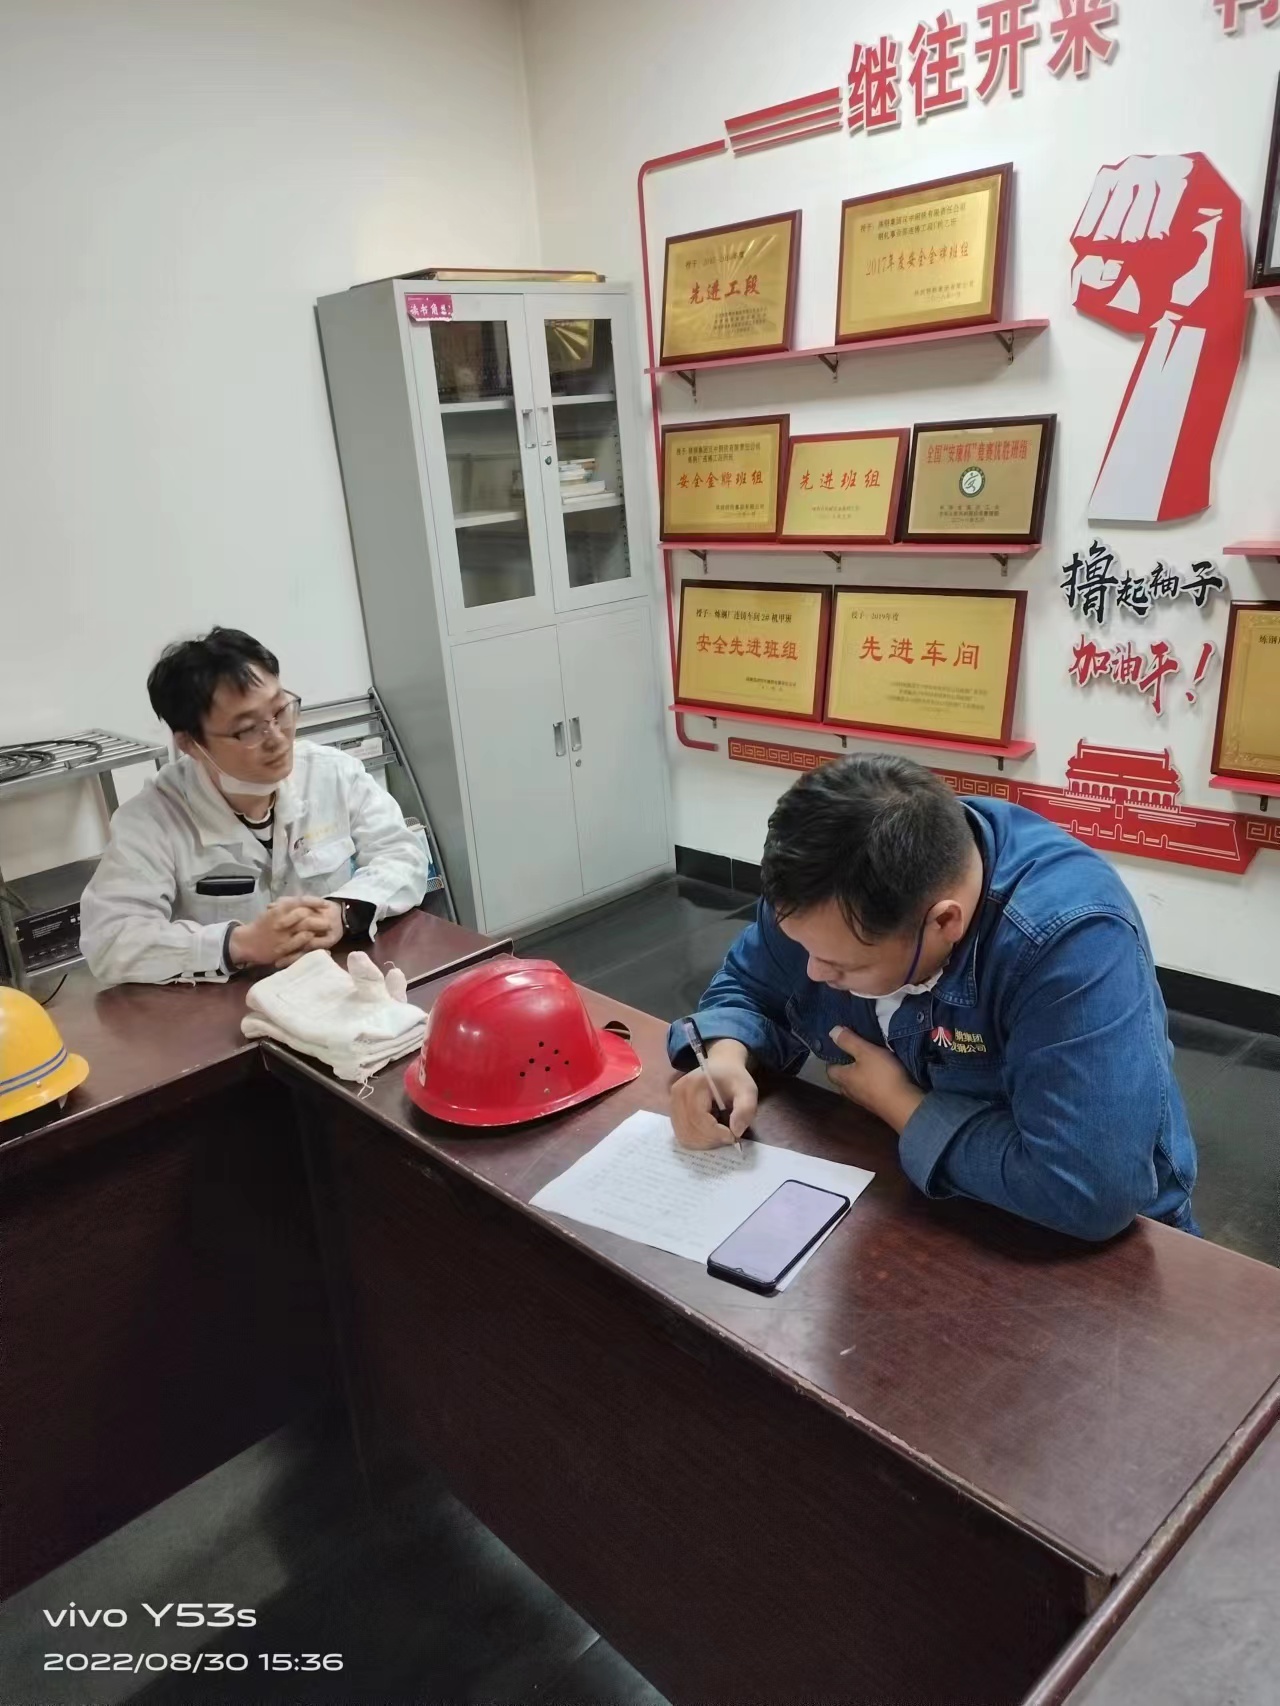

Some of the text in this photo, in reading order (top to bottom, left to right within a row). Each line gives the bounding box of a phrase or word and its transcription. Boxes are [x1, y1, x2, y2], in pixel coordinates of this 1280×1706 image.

[846, 0, 1117, 133] 继往开来
[688, 273, 761, 305] 先进工段
[677, 469, 764, 489] 安全金牌班组
[799, 468, 881, 491] 先进班组
[1059, 538, 1226, 624] 撸起袖子
[696, 632, 800, 662] 安全先进班组
[858, 635, 981, 671] 先进车间
